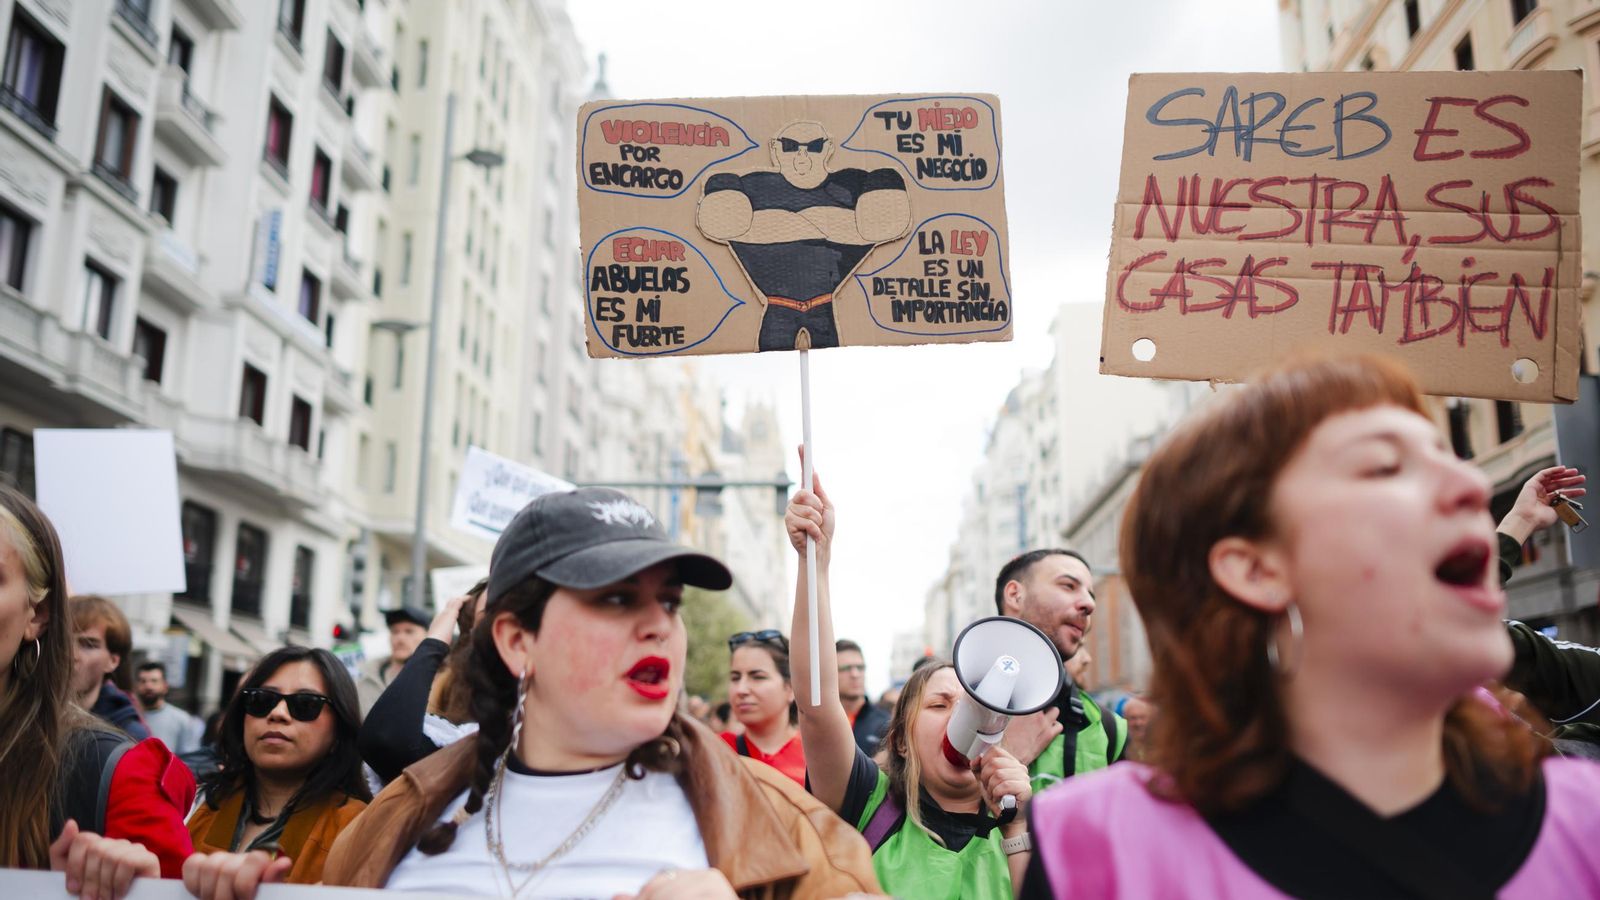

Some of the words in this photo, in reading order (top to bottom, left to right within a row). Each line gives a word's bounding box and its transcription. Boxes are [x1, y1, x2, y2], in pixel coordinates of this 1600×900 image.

[873, 111, 912, 131] TU
[918, 102, 979, 132] MIEDO
[1146, 84, 1393, 163] SAREB
[1413, 94, 1531, 161] ES
[600, 120, 730, 147] VIOLENCIA
[896, 133, 926, 153] ES
[620, 144, 661, 163] POR
[589, 163, 684, 190] ENCARGO
[916, 153, 987, 182] NEGOCIO
[1133, 173, 1422, 264] NUESTRA,
[1426, 176, 1561, 245] SUS
[613, 237, 686, 262] ECHAR
[918, 230, 945, 255] LA
[950, 229, 988, 257] LEY
[591, 264, 691, 294] ABUELAS
[924, 260, 950, 277] ES
[957, 260, 984, 278] UN
[873, 278, 952, 298] DETALLE
[957, 280, 991, 300] SIN
[1116, 250, 1300, 319] CASAS
[595, 296, 625, 323] ES
[890, 295, 1008, 324] IMPORTANCIA
[612, 324, 685, 348] FUERTE
